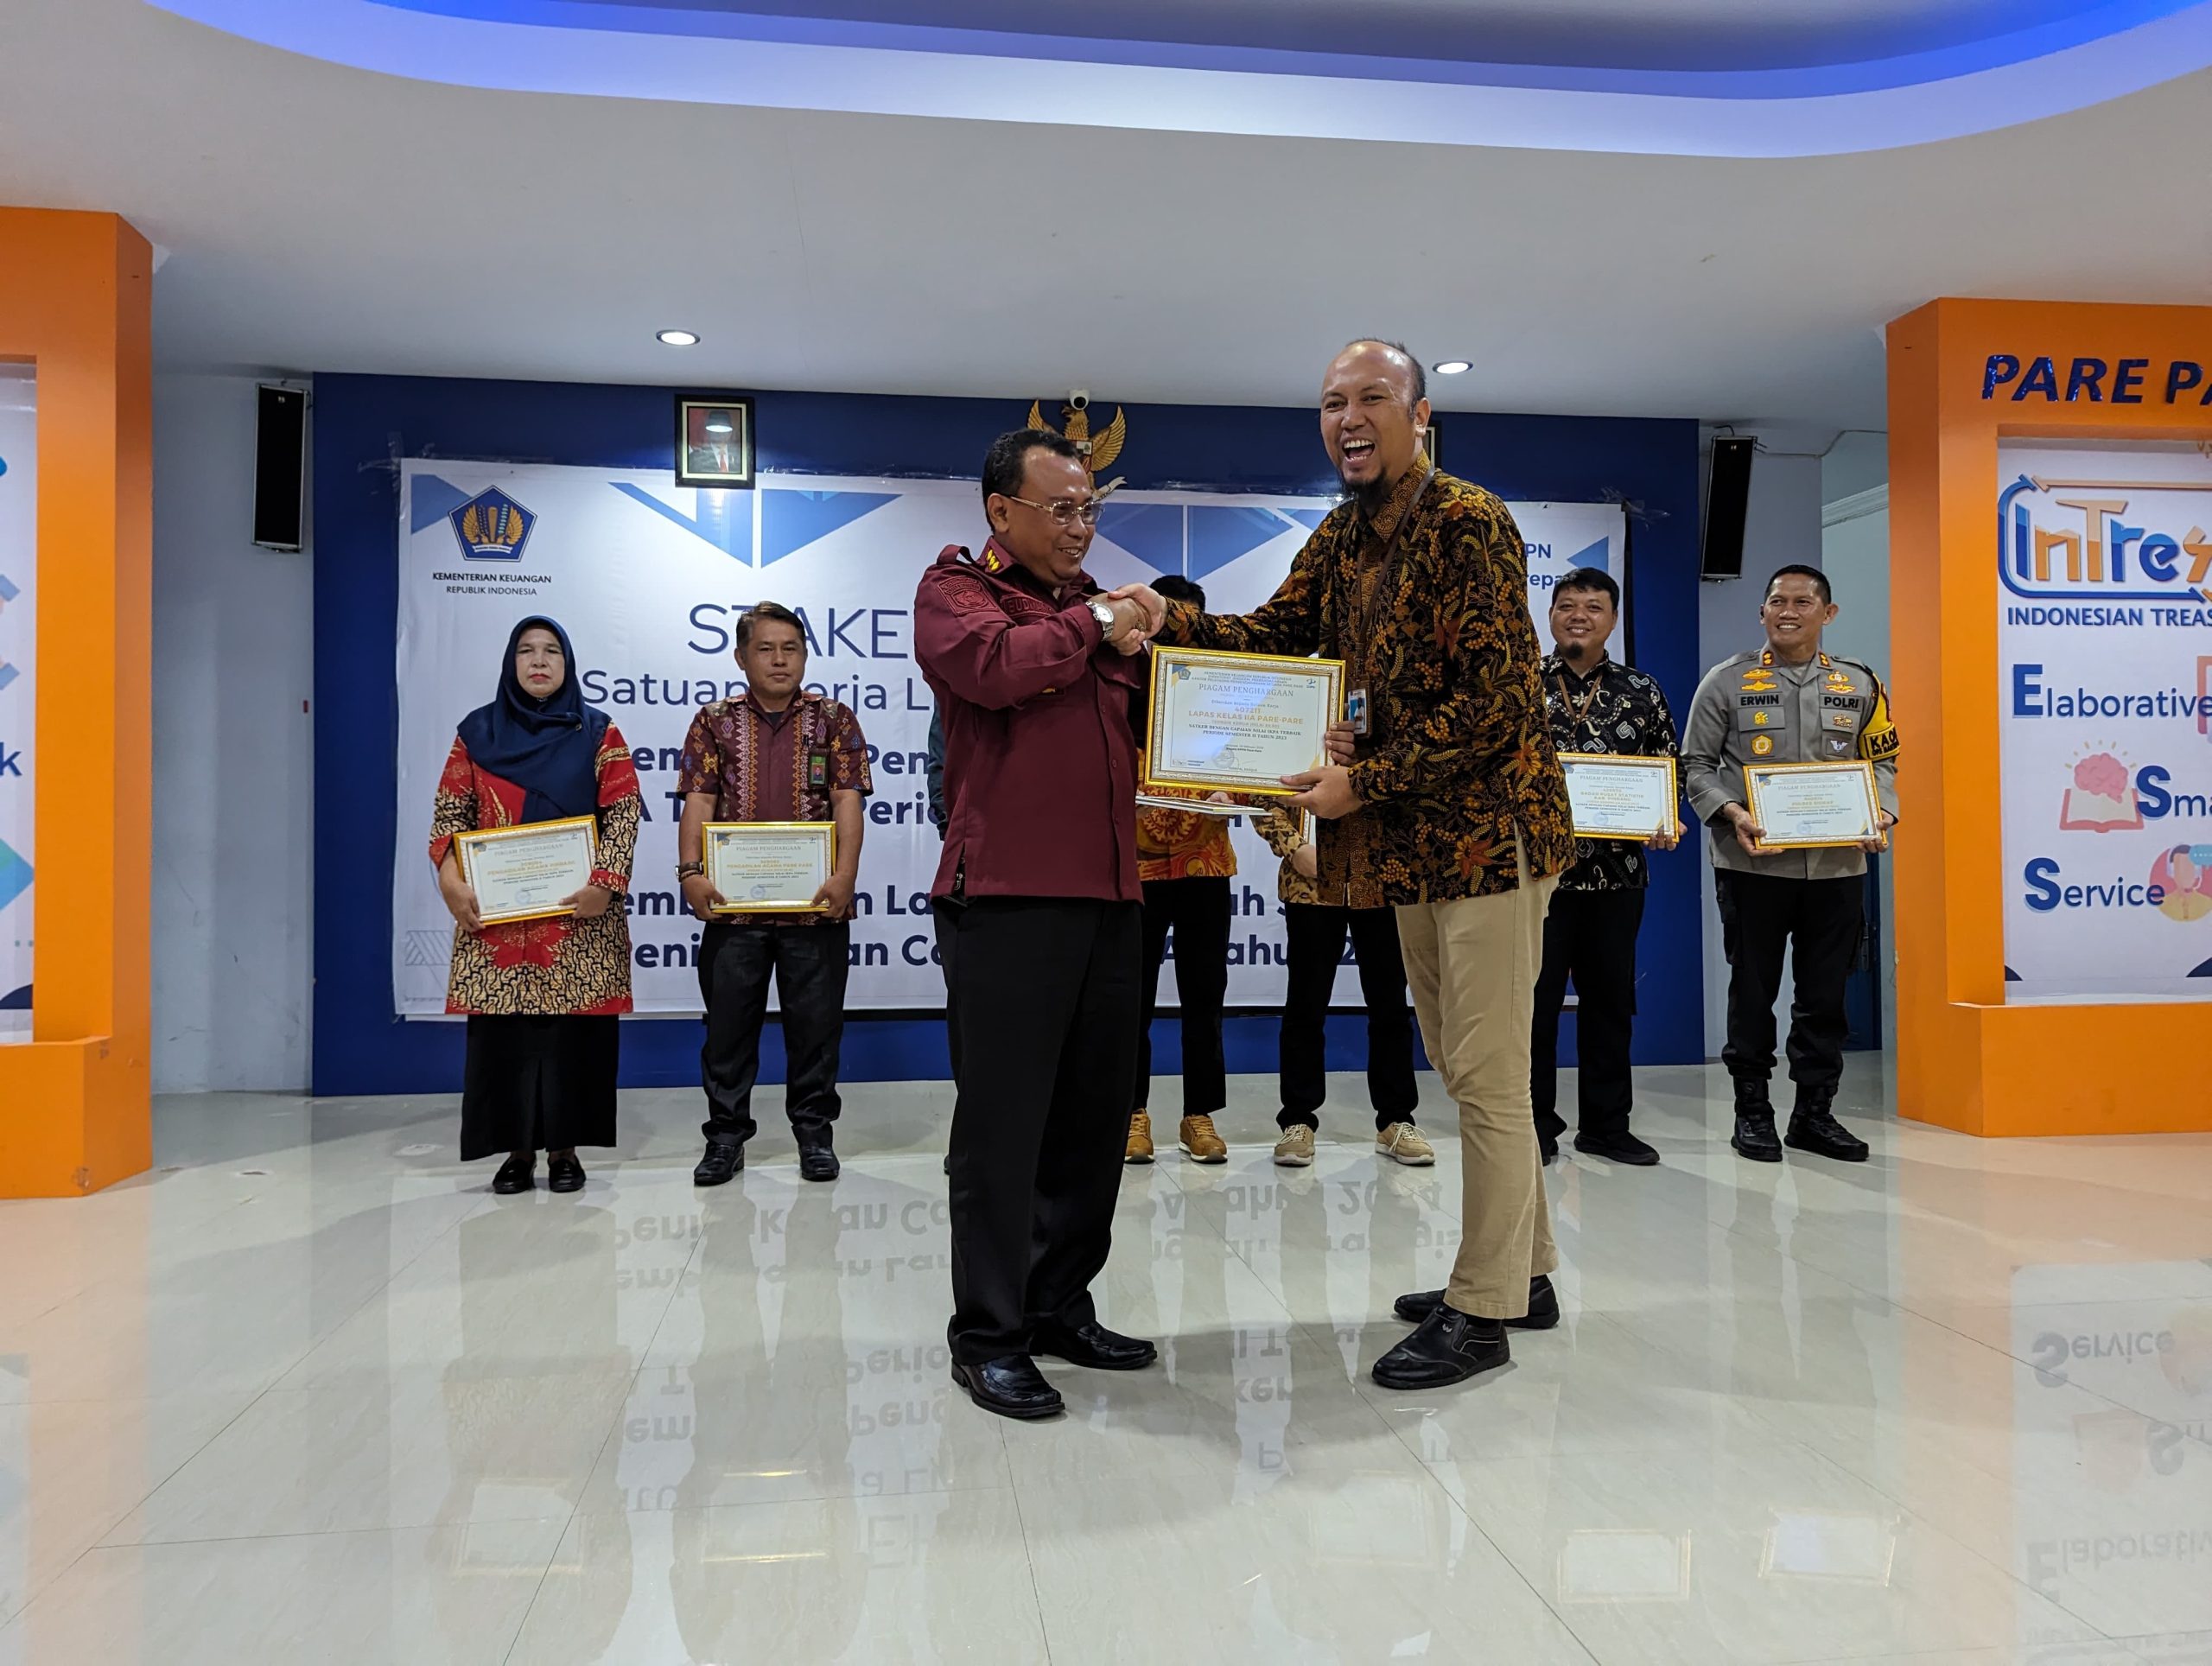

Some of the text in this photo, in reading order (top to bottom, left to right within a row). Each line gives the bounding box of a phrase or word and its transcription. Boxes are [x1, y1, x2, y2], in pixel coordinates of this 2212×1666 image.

[1982, 354, 2212, 406] PARE P
[1525, 544, 1551, 558] PN
[433, 572, 552, 583] KEMENTERIAN KEUANGAN
[487, 587, 537, 595] INDONESIA
[2008, 607, 2143, 626] INDONESIAN
[804, 674, 887, 715] erja
[1198, 684, 1294, 696] PIAGAM PENGHARGAAN
[1740, 695, 1779, 705] ERWIN
[1824, 696, 1859, 708] POLRI
[1217, 712, 1243, 721] KELAS
[1258, 715, 1304, 724] PARE-PARE
[866, 744, 930, 775] Pen
[2136, 766, 2212, 818] Sm
[2024, 857, 2166, 911] Service
